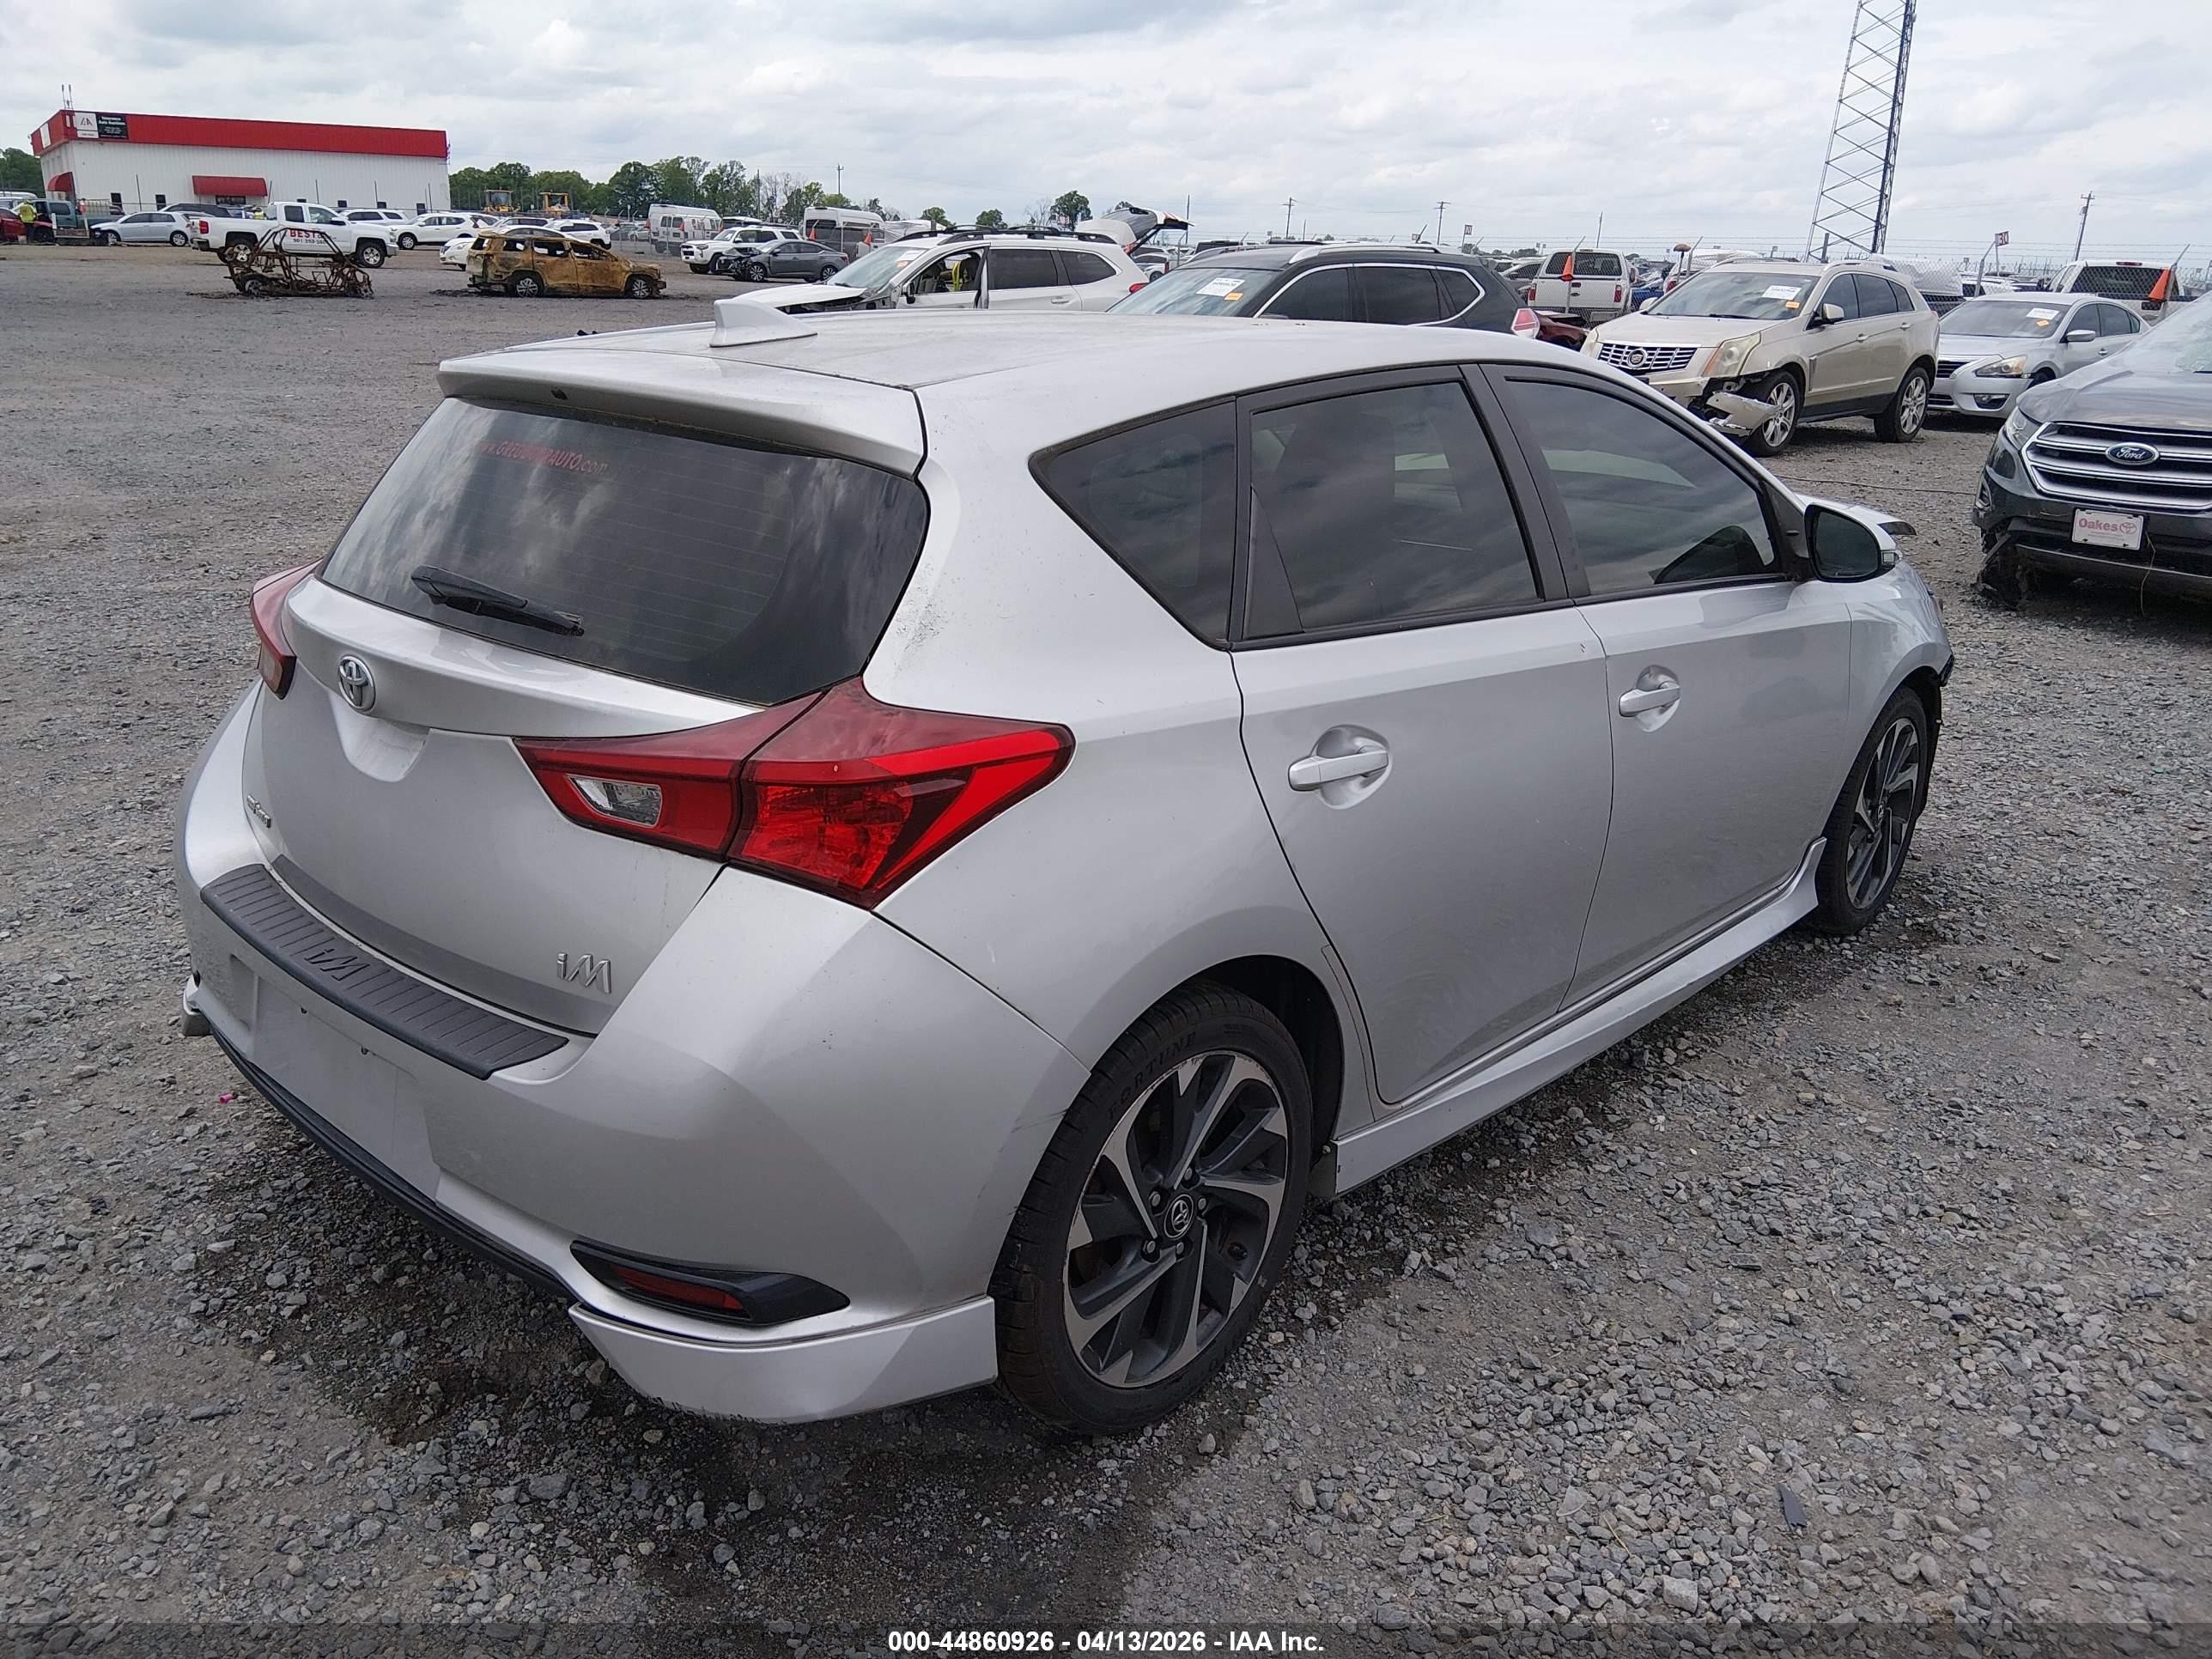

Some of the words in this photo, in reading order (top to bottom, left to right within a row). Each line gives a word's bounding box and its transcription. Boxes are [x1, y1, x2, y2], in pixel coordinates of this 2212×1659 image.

[289, 229, 316, 239] BEST
[2117, 447, 2147, 459] Ford
[2078, 518, 2118, 532] Oakes
